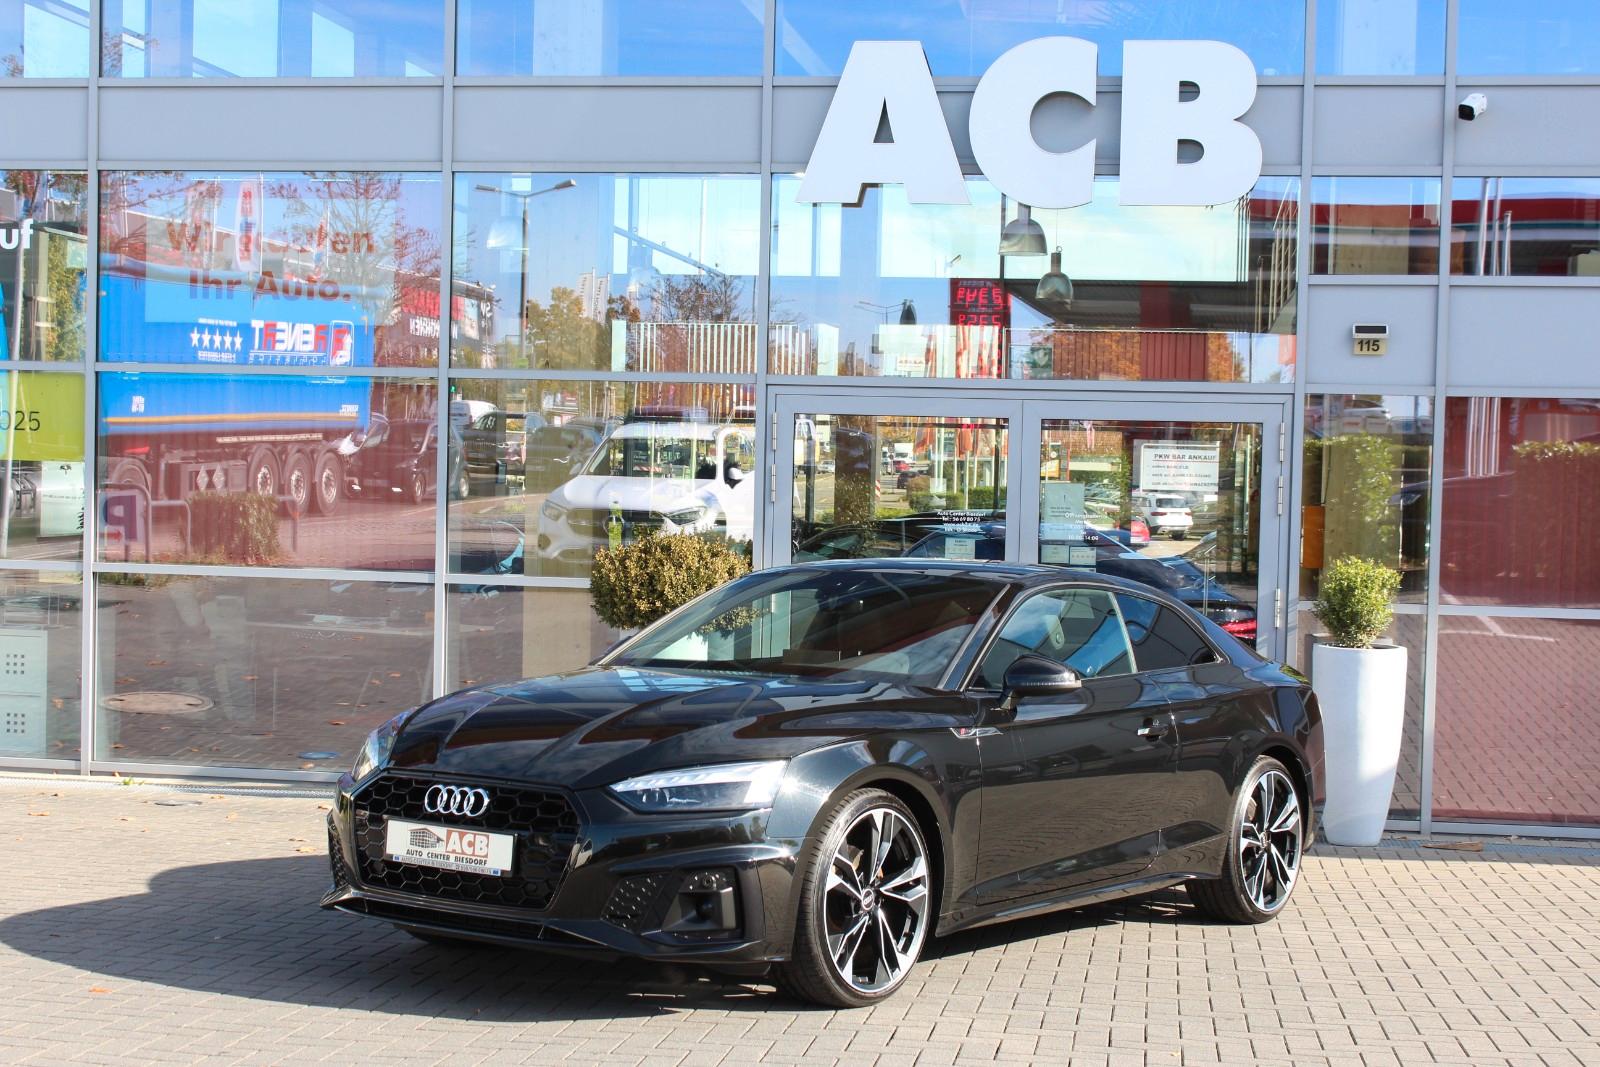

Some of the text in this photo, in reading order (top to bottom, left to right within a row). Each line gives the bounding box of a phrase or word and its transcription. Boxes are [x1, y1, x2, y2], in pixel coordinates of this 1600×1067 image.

[795, 36, 1263, 209] ACB
[189, 270, 243, 300] Ihr
[1357, 339, 1380, 352] 115
[446, 830, 489, 857] ACB
[406, 848, 424, 857] AUTO
[427, 851, 450, 861] CENTER
[454, 855, 488, 867] BIESDORF
